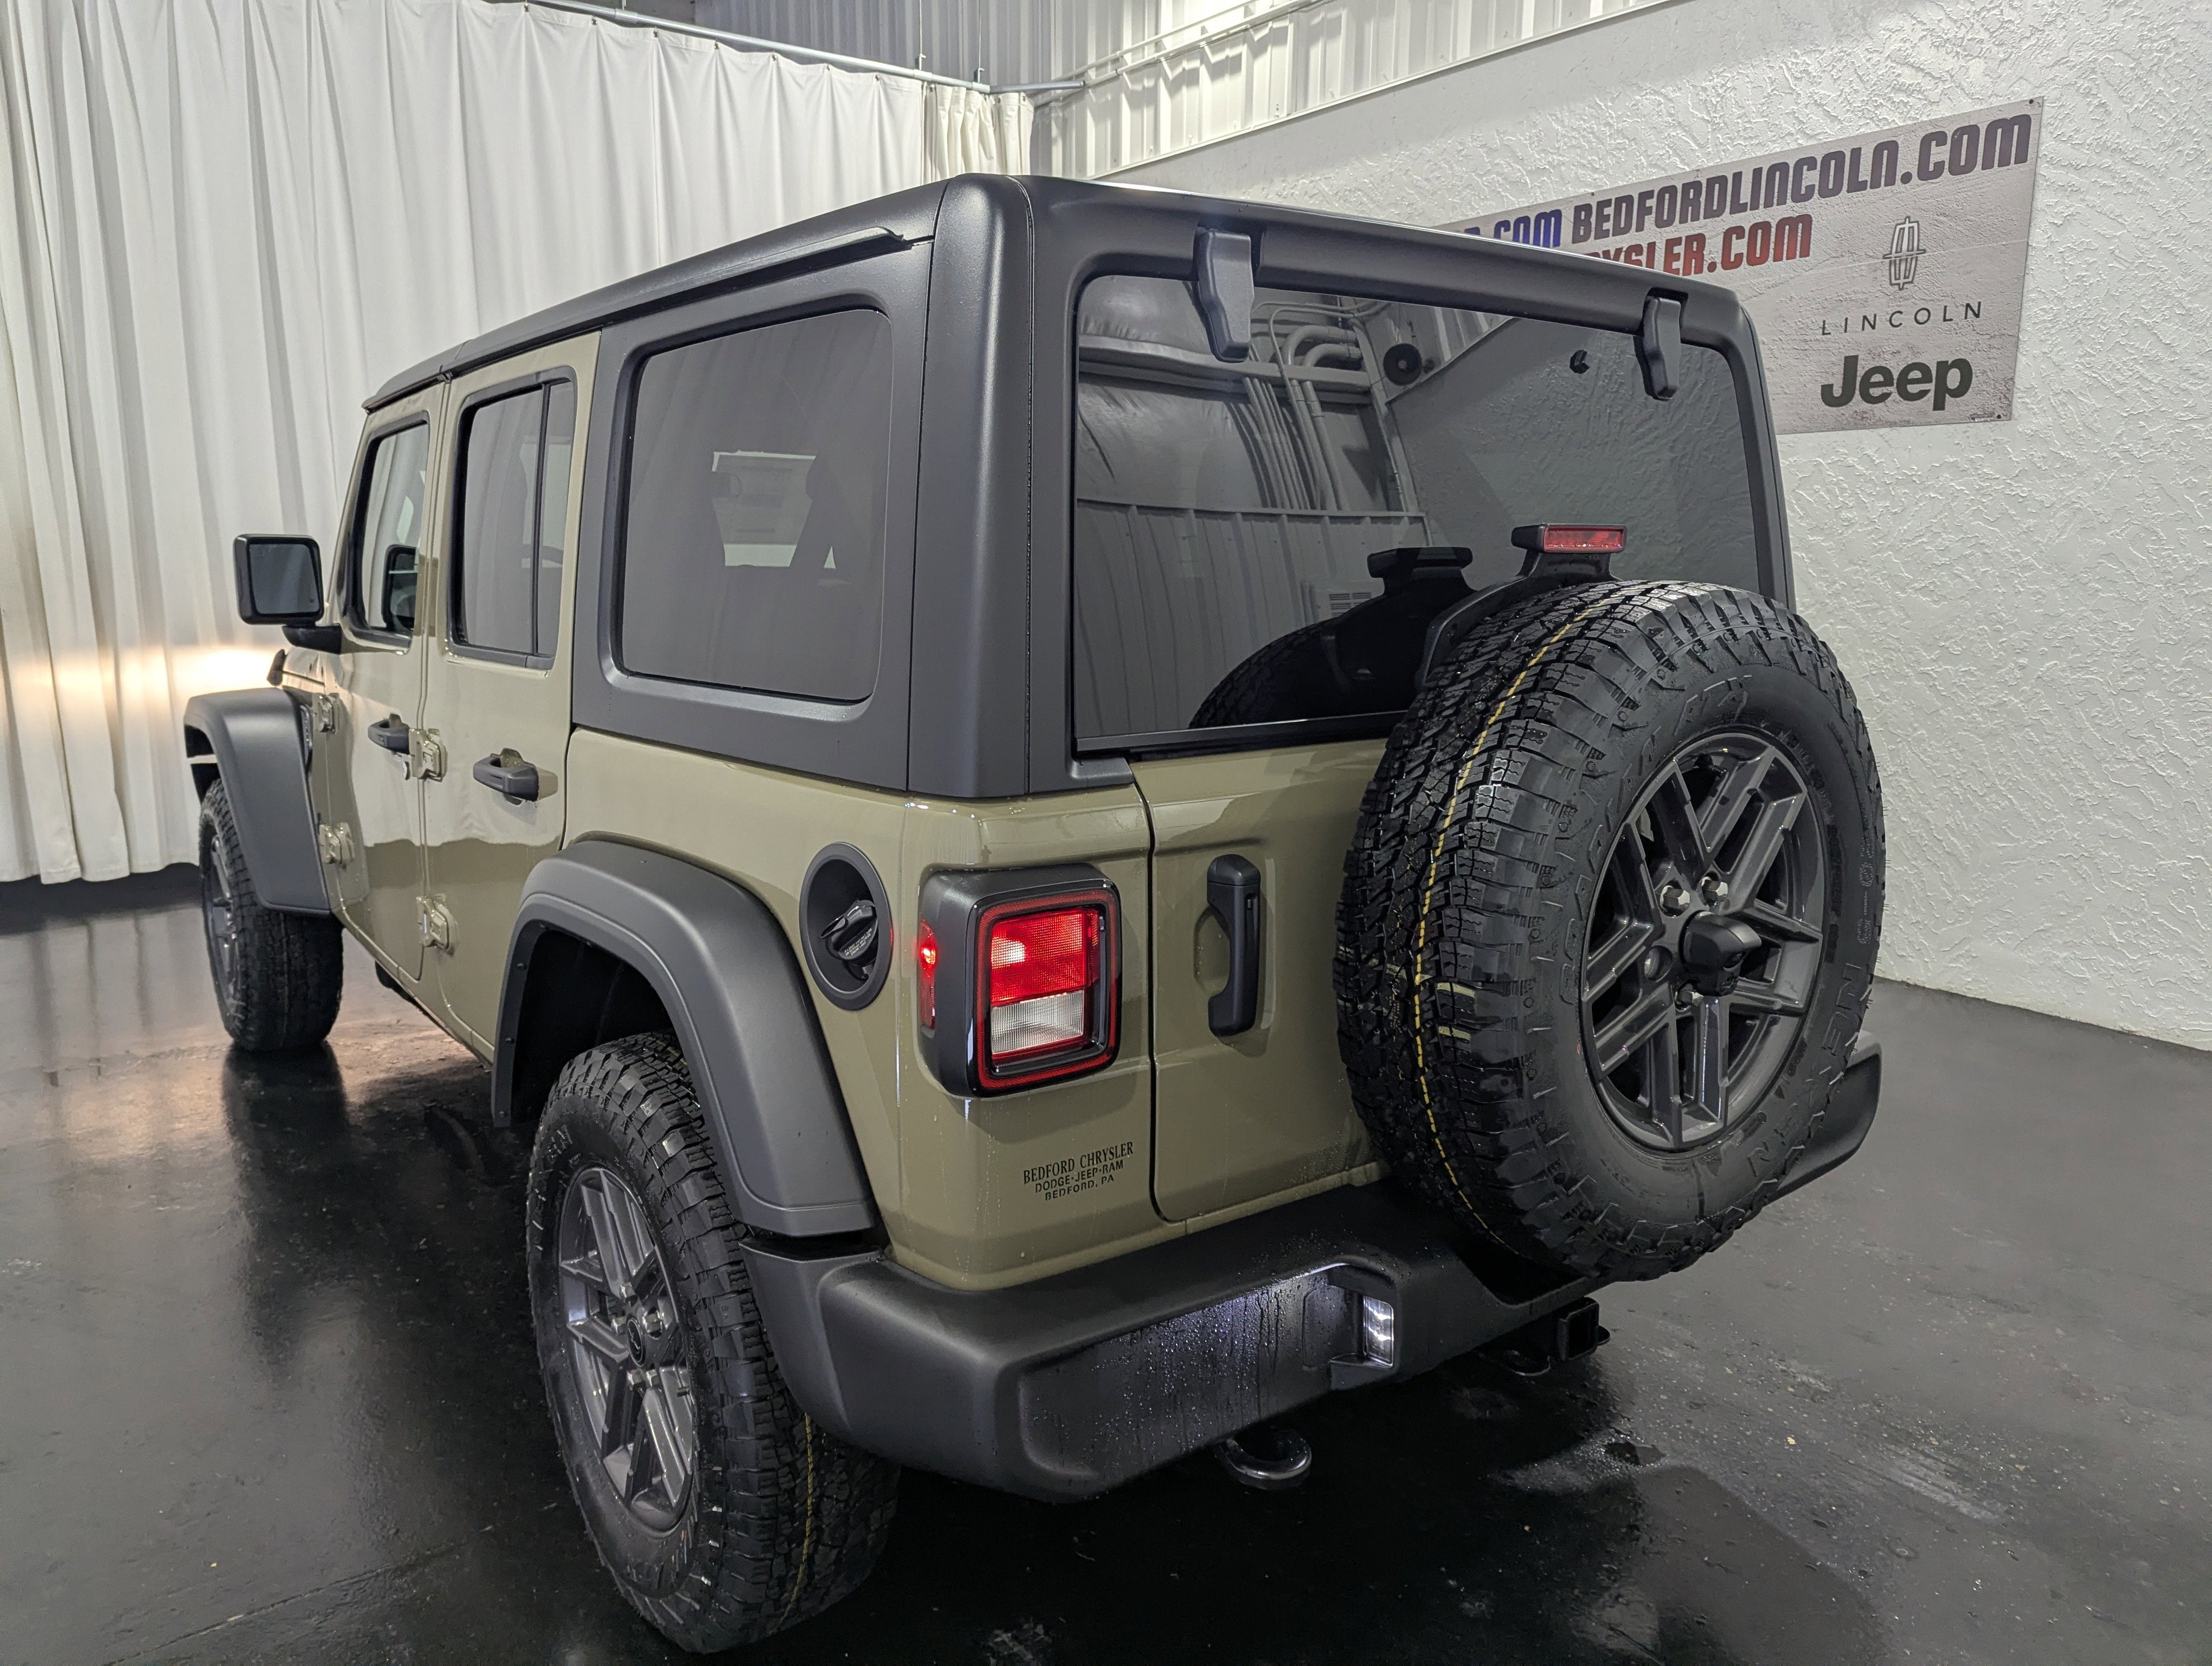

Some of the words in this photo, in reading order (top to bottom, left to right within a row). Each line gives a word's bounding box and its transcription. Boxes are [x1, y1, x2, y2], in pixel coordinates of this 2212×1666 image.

[1572, 114, 2031, 244] BEDFORDLINCOLN.COM
[1822, 301, 1982, 336] LINCOLN
[1821, 353, 1973, 412] Jeep
[1024, 1158, 1075, 1184] BEDFORD
[1080, 1142, 1133, 1168] CHRYSLER
[1045, 1180, 1098, 1201] BEDFORD,
[1101, 1174, 1114, 1184] PA
